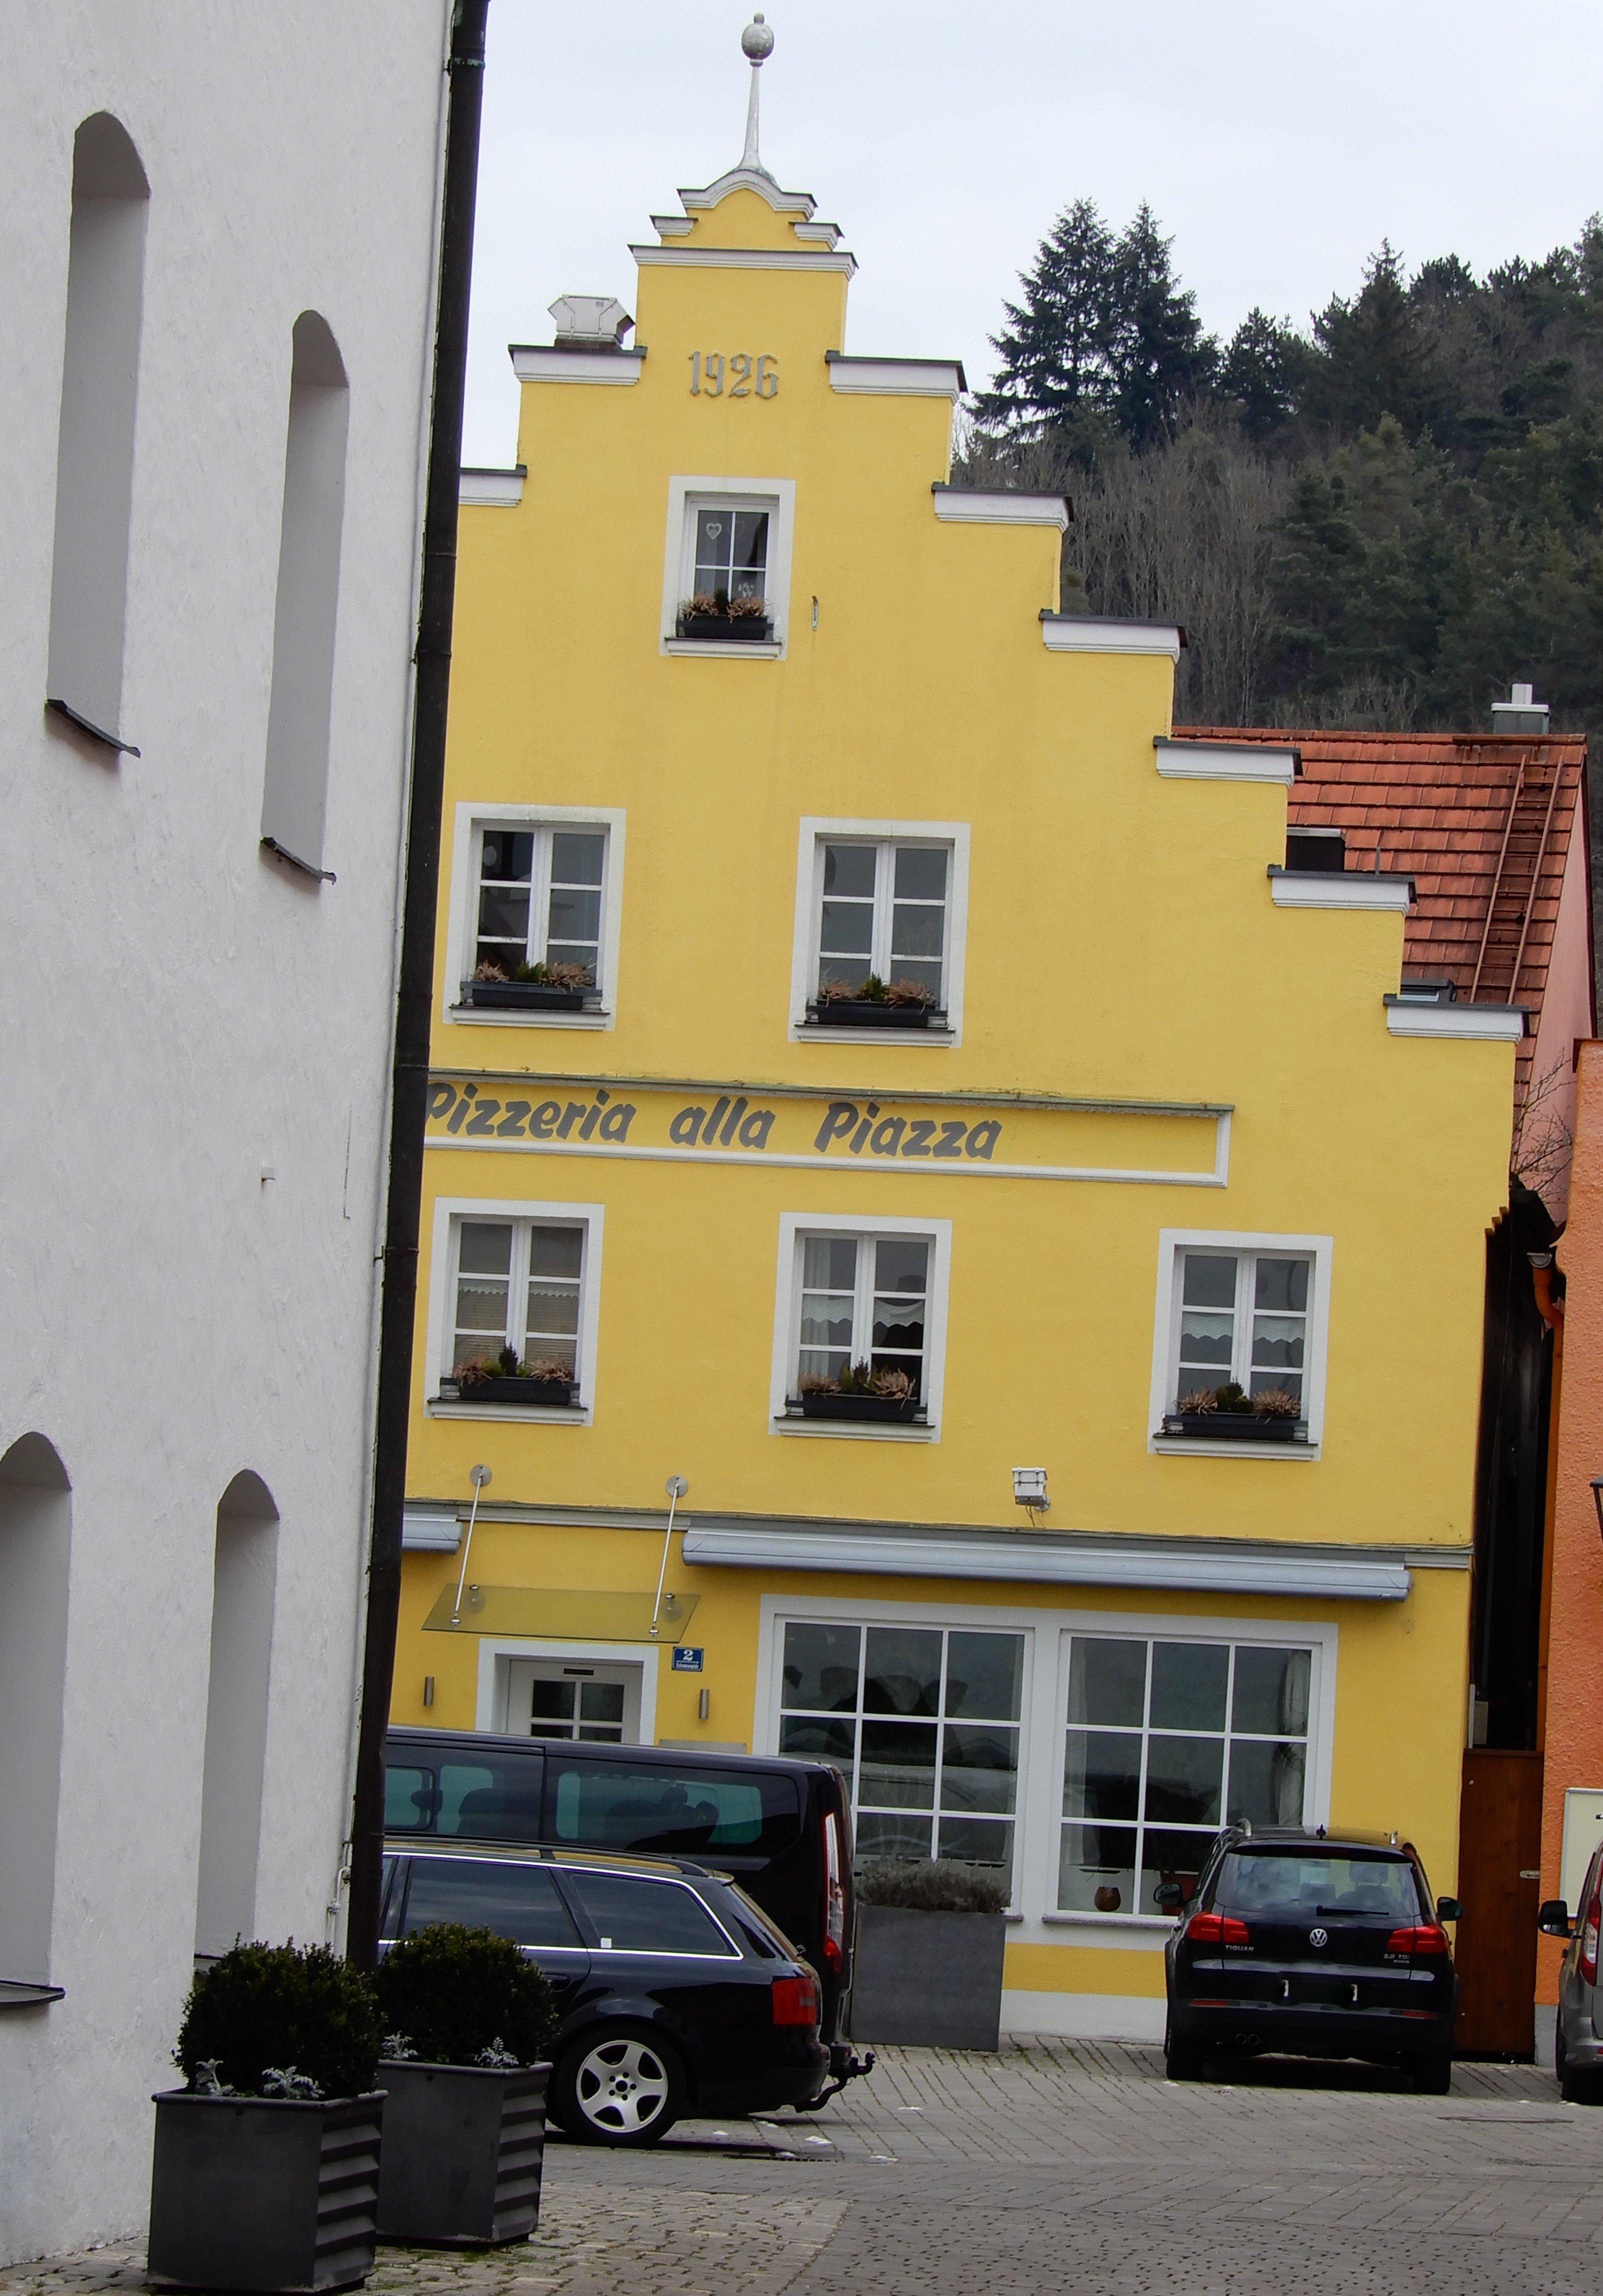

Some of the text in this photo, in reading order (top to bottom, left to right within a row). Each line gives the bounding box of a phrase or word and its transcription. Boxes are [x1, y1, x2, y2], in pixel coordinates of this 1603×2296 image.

[688, 350, 779, 399] 1926
[669, 1096, 776, 1149] alla
[813, 1102, 1003, 1160] Piazza
[682, 1649, 694, 1661] 2
[1309, 1928, 1328, 1947] VW
